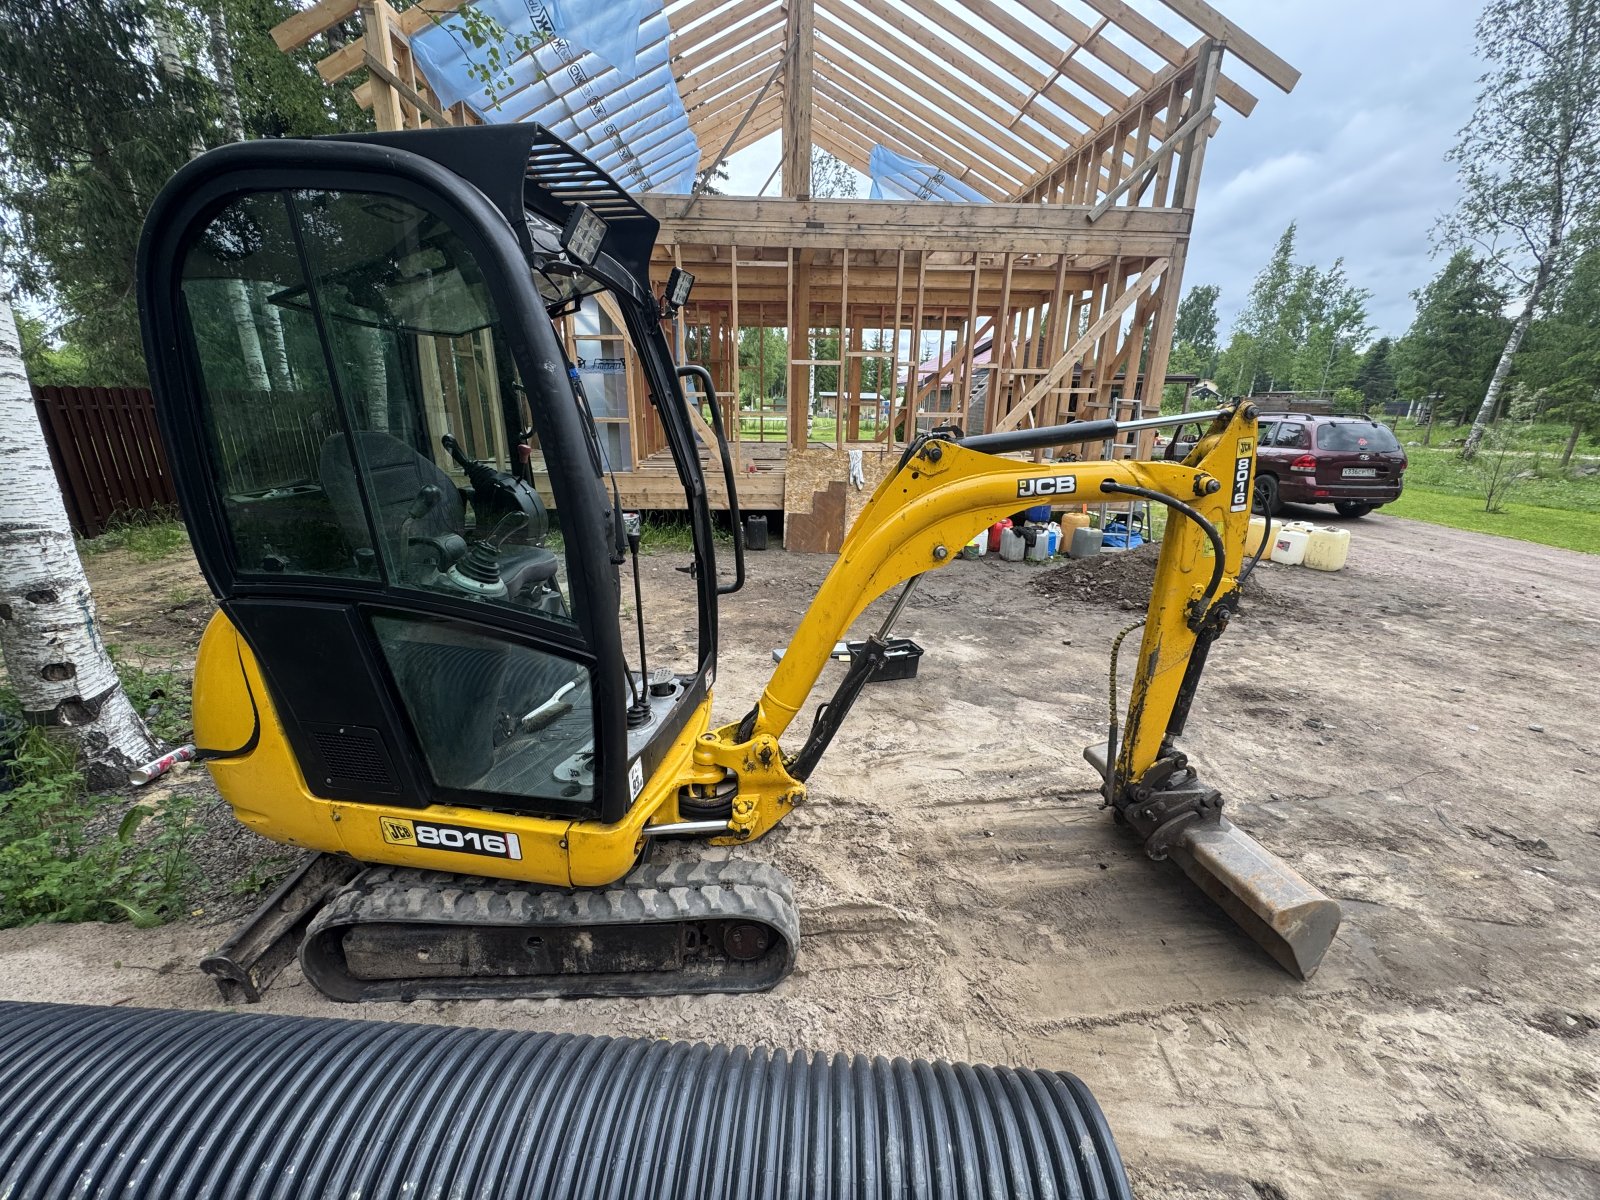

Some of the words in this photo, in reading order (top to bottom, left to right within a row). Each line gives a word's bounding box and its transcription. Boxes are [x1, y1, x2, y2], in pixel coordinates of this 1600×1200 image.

[1240, 442, 1251, 455] JCB
[1019, 476, 1076, 496] JCB
[1233, 458, 1249, 504] 8016
[388, 823, 413, 839] JCB
[416, 825, 507, 854] 8016
